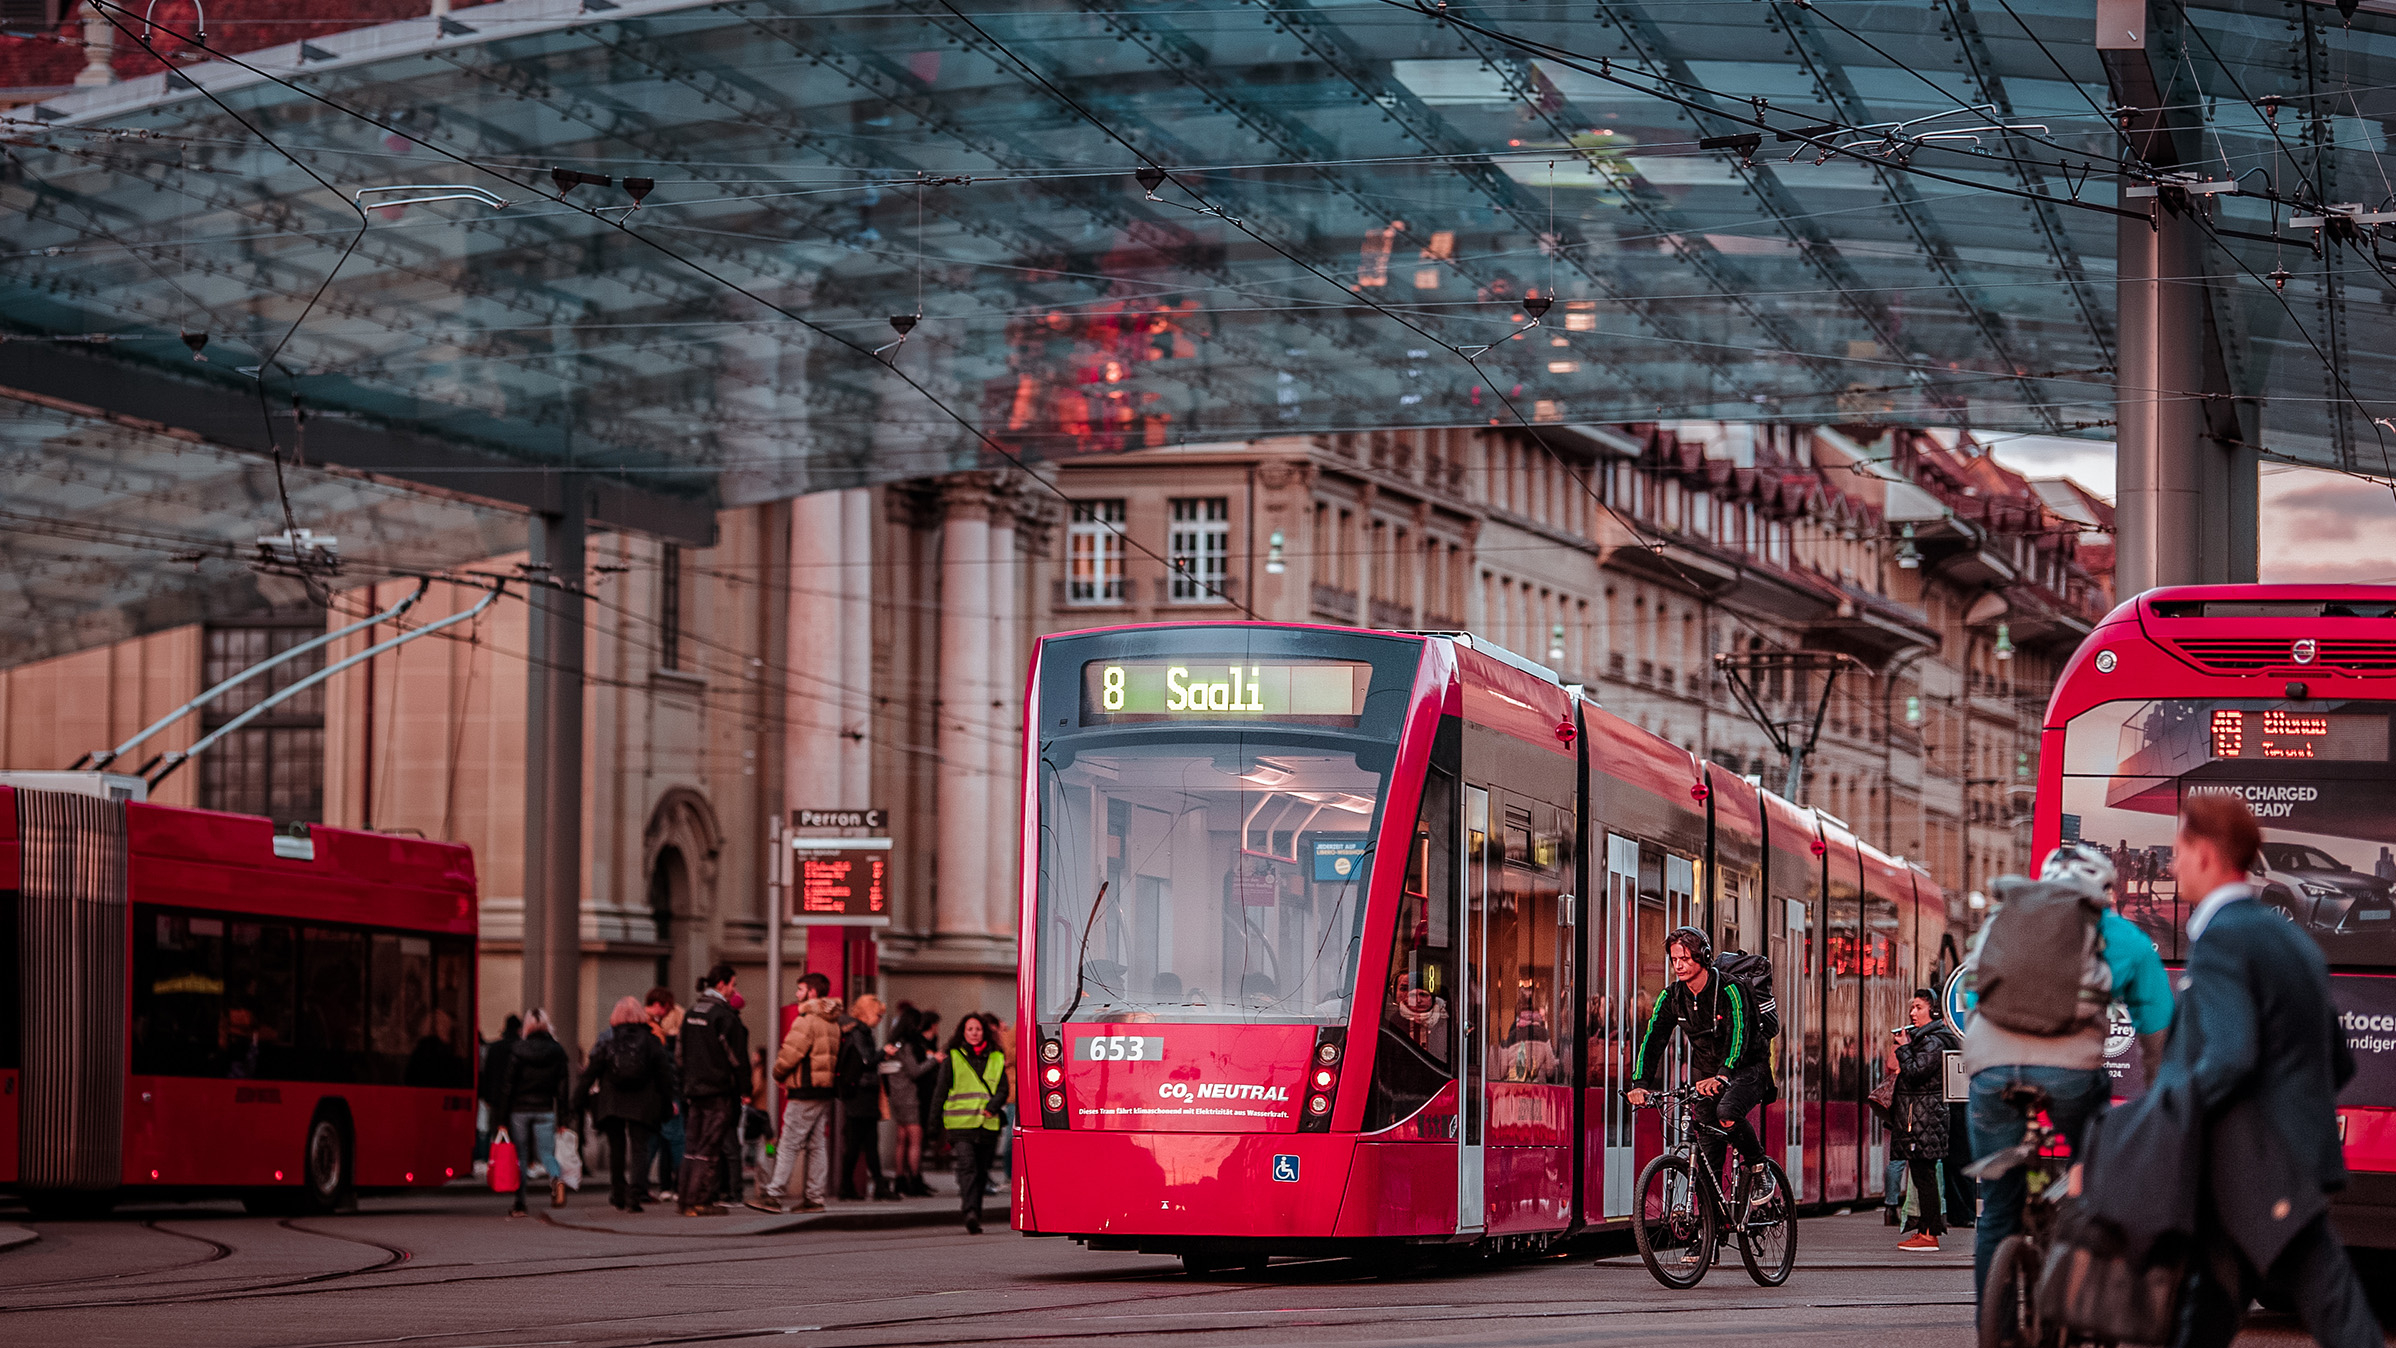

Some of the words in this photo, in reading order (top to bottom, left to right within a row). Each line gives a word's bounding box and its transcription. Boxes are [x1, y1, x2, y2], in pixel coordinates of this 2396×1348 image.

[1103, 666, 1125, 711] 8
[1166, 665, 1264, 711] Saali
[2245, 786, 2318, 801] CHARGED
[801, 809, 862, 827] Perron
[866, 809, 879, 827] C
[1428, 964, 1435, 993] 8
[2338, 1010, 2396, 1031] toce
[2110, 1023, 2136, 1038] Frey
[1089, 1036, 1145, 1061] 653
[2346, 1034, 2396, 1053] ndige
[1957, 1063, 1968, 1074] Li
[1197, 1083, 1290, 1101] NEUTRAL
[1116, 1107, 1133, 1115] fährt
[1133, 1107, 1182, 1115] klimaschonend
[1195, 1108, 1233, 1116] Elektrizität
[1246, 1109, 1290, 1119] Wasserkraft.
